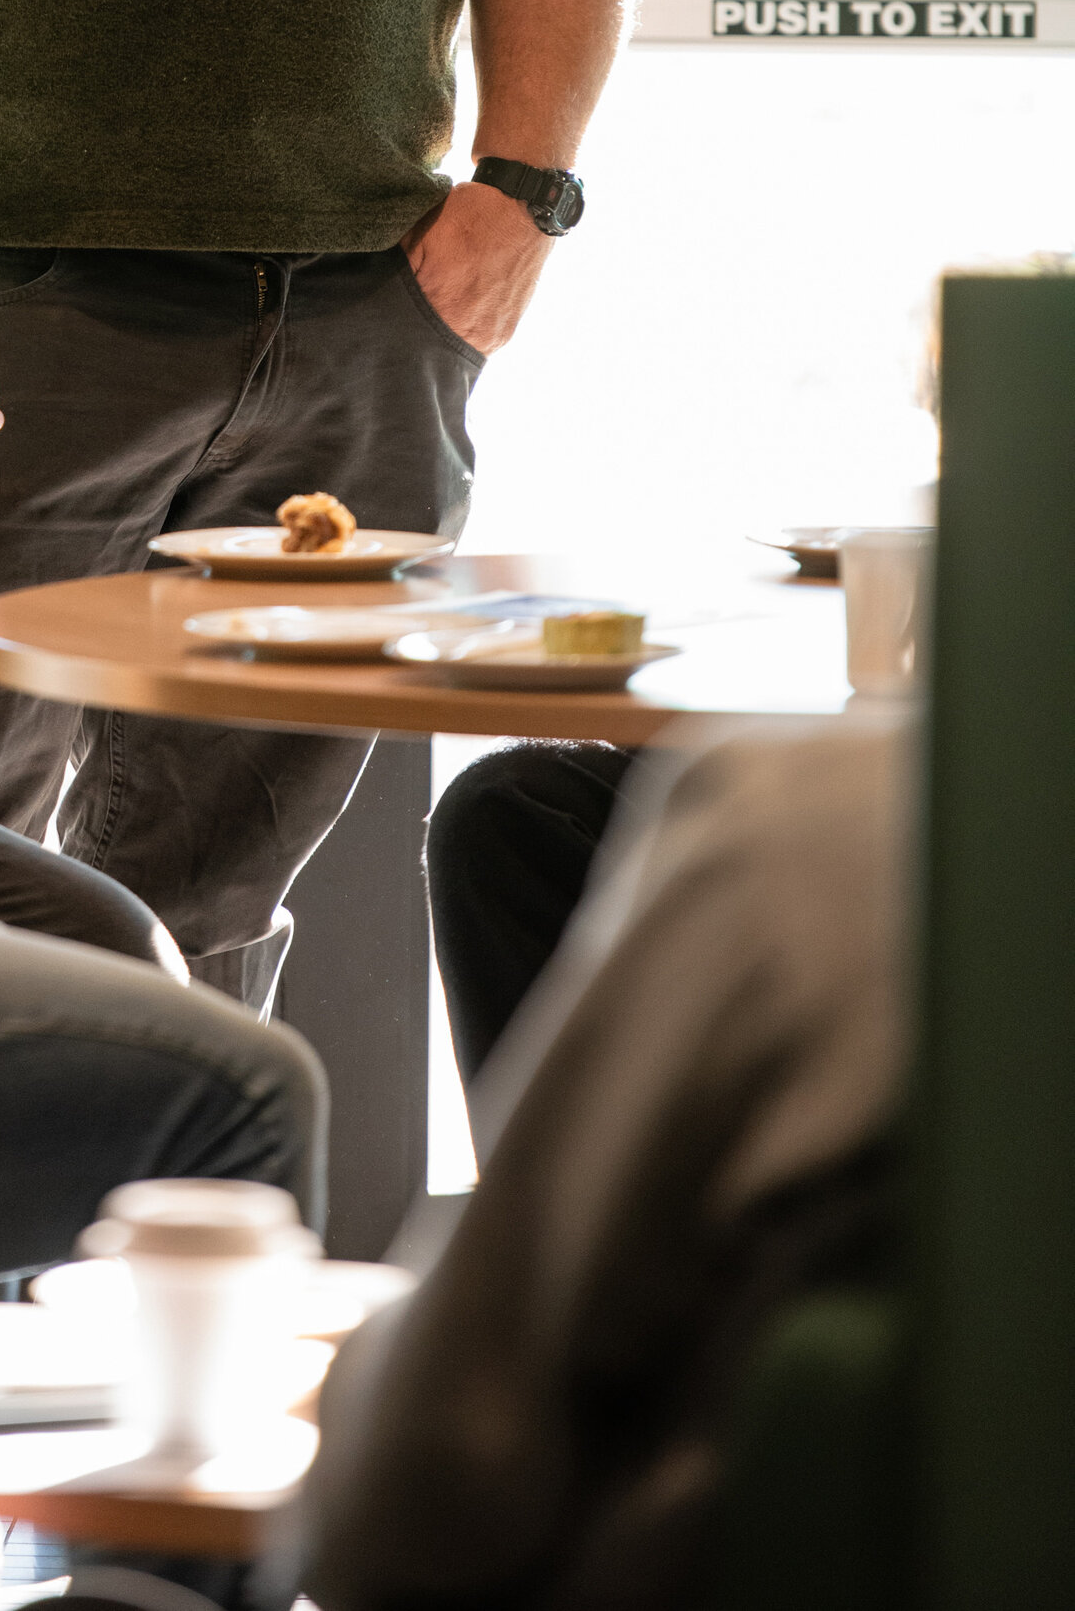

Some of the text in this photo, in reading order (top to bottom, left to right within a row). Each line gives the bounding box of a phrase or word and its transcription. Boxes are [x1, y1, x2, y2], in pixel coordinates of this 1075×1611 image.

[715, 1, 1034, 38] PUSH TO EXIT
